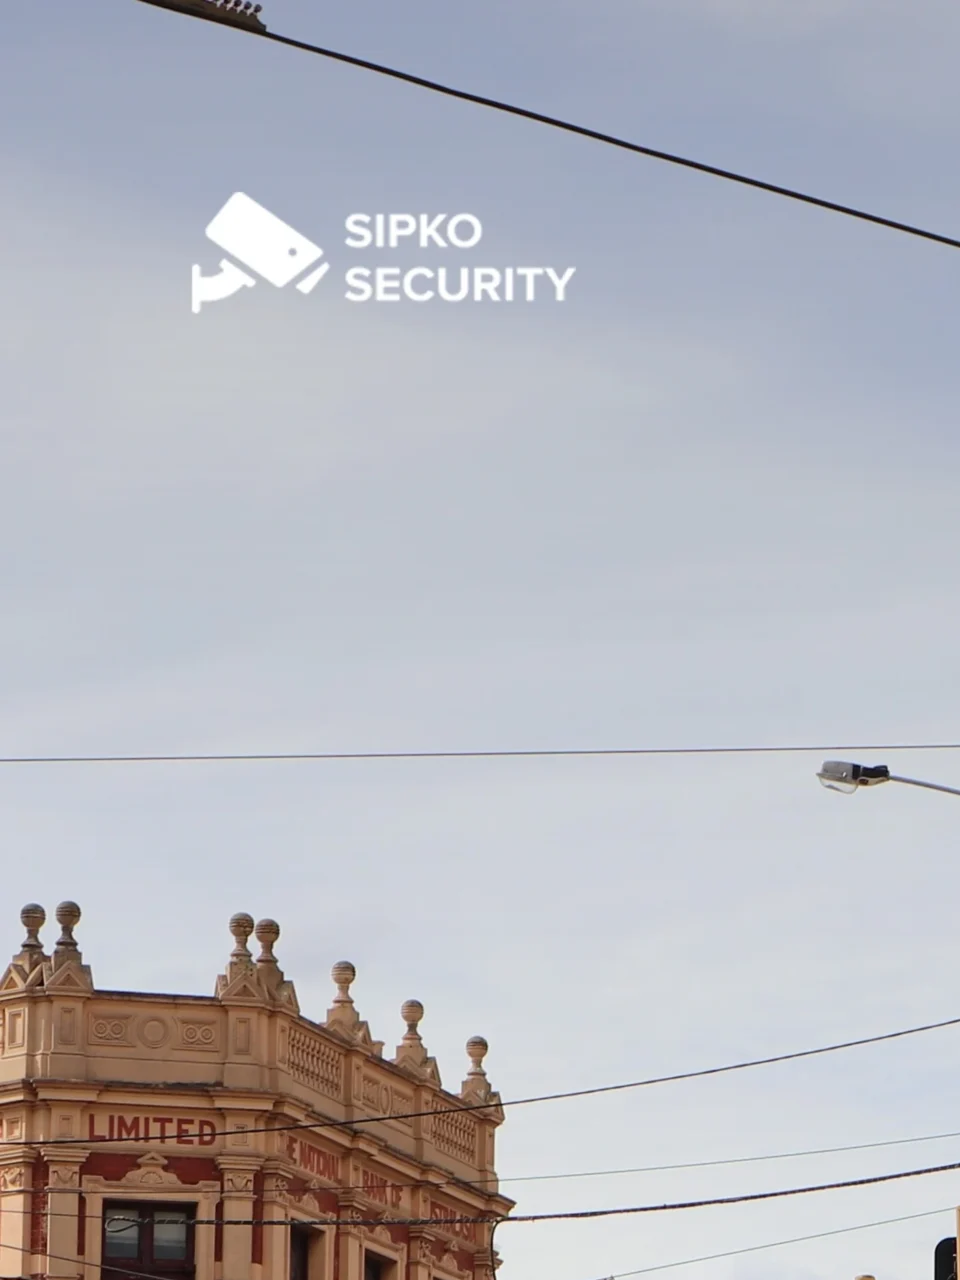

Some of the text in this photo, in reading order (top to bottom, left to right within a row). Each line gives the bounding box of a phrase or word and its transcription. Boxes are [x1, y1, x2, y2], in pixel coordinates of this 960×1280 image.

[88, 1113, 216, 1146] LIMITED
[363, 1169, 388, 1205] BANK
[391, 1182, 403, 1210] OF
